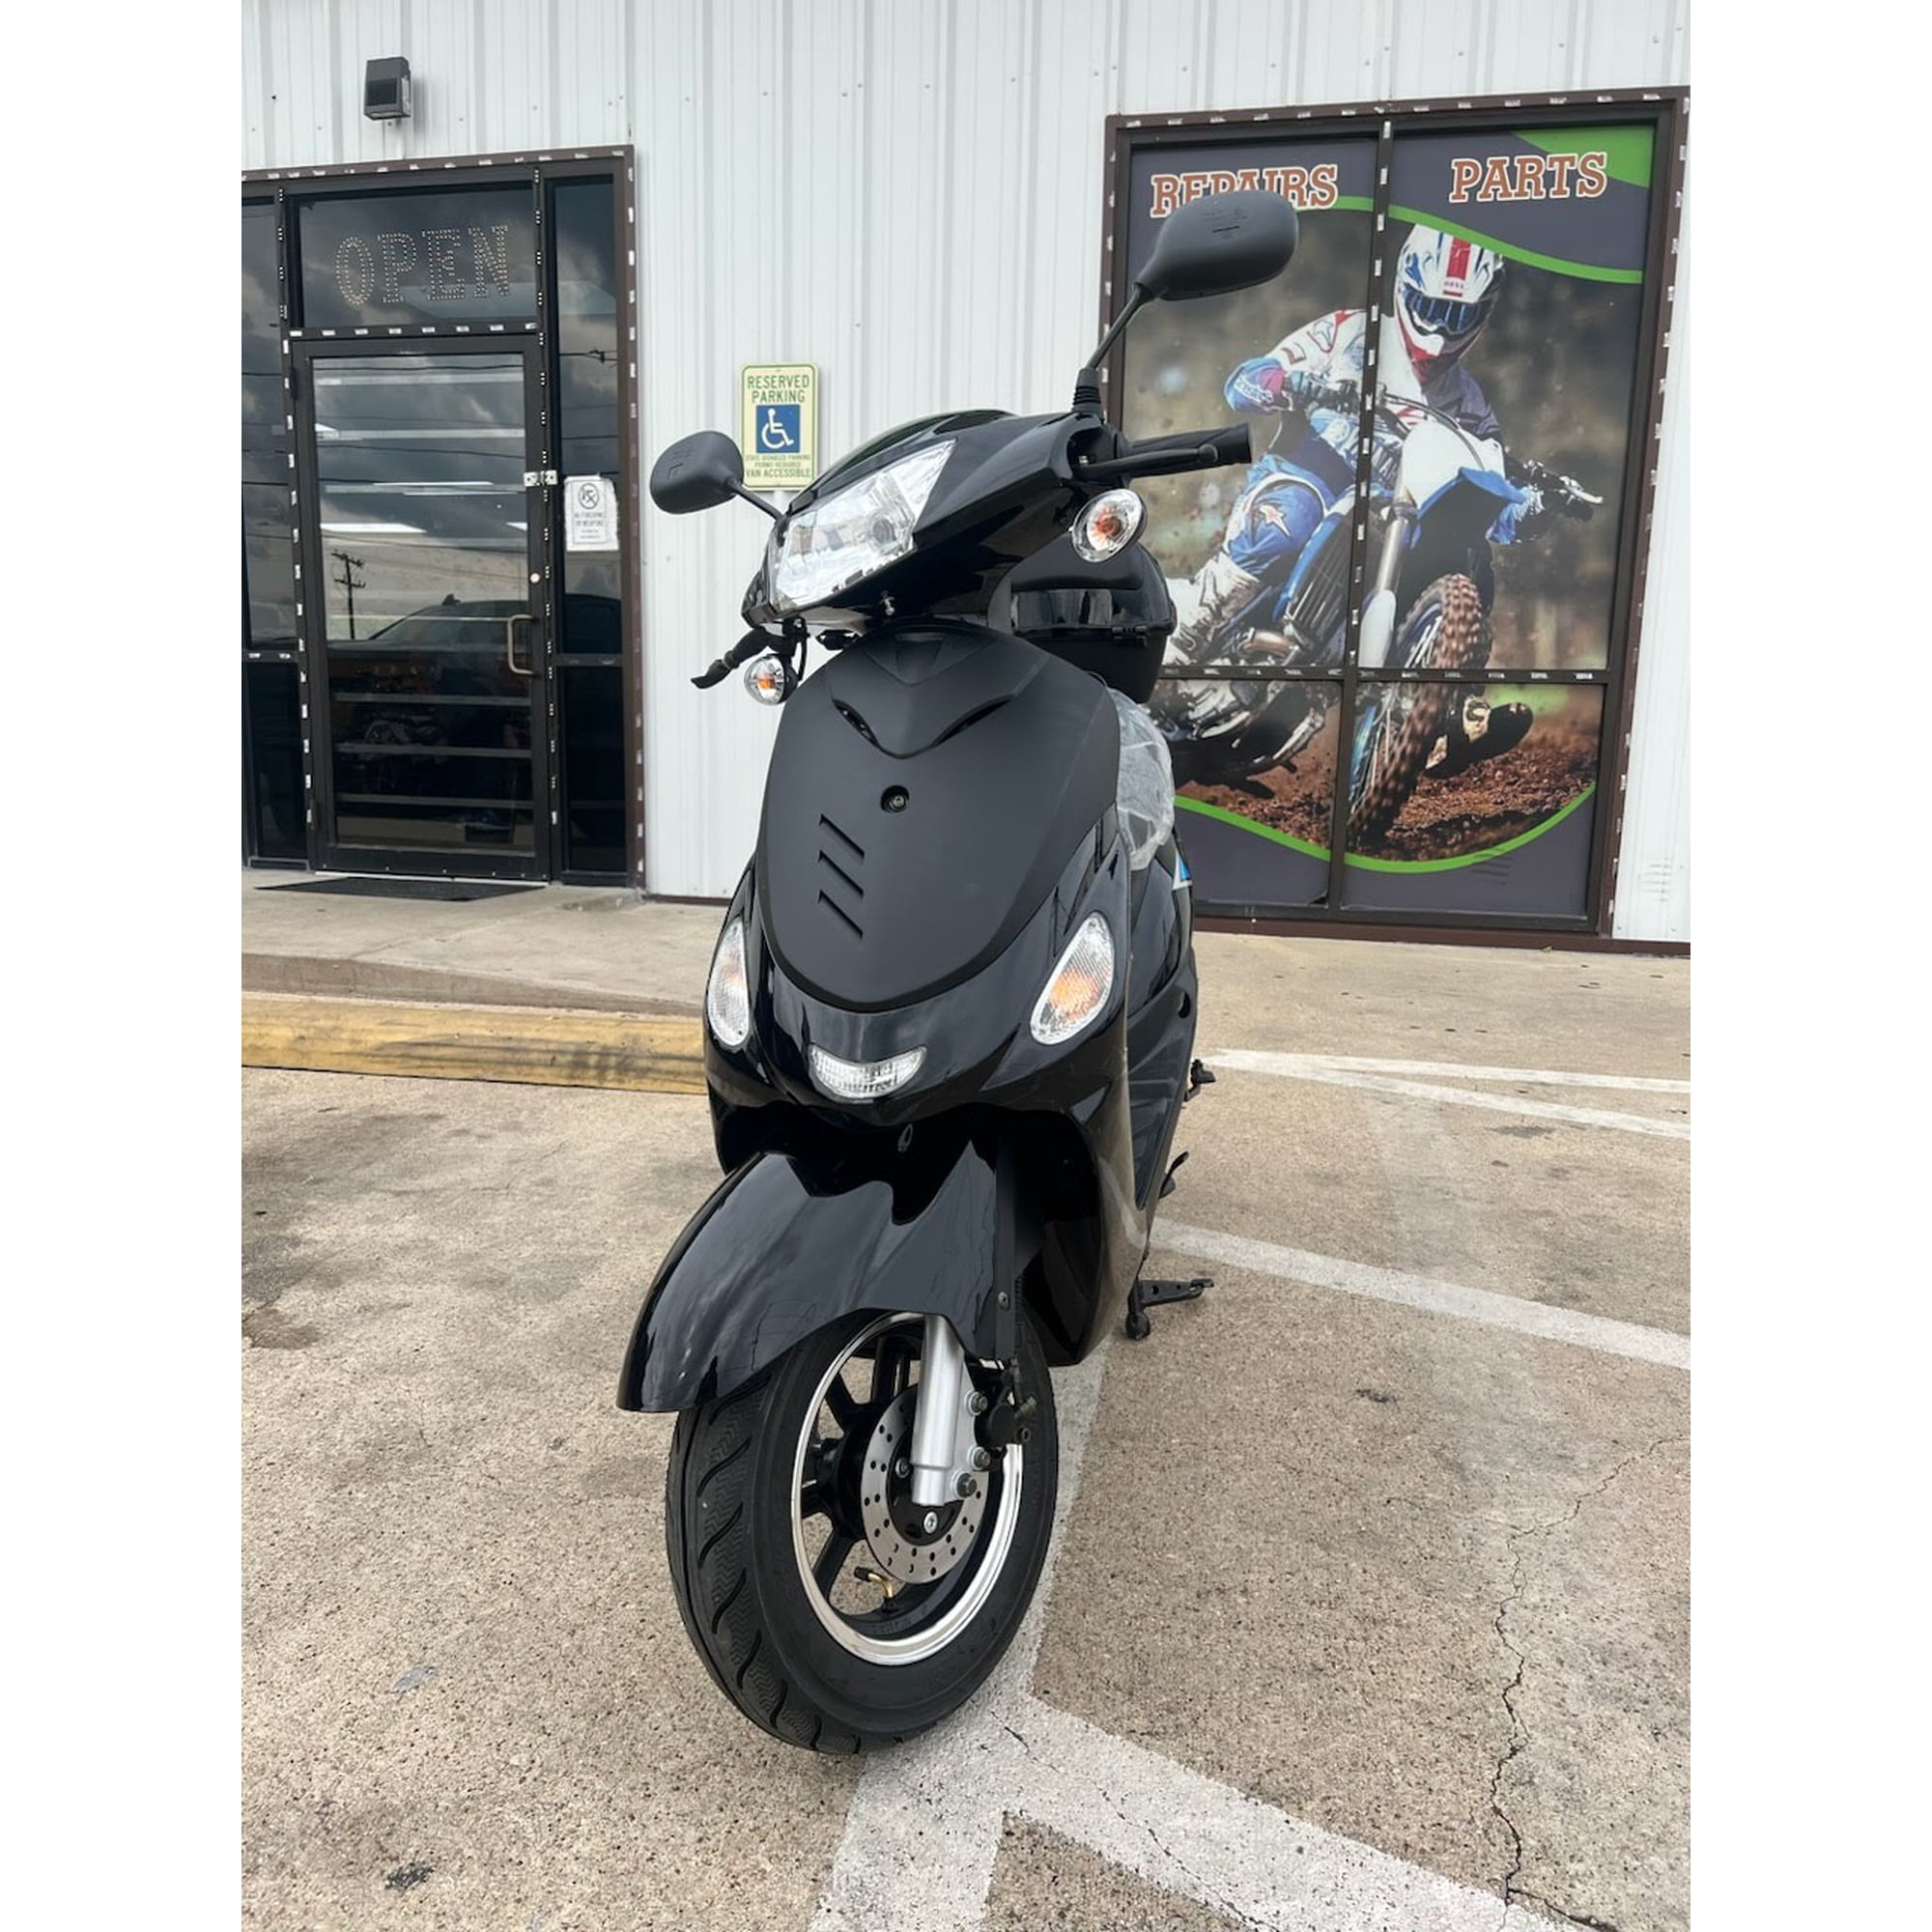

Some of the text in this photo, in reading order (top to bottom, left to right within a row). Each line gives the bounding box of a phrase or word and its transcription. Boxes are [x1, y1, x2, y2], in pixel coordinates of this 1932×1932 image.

[1449, 152, 1607, 203] PARTS
[336, 225, 508, 307] OPEN
[747, 375, 810, 388] RESERVED
[752, 389, 806, 403] PARKING
[746, 469, 811, 477] VAN ACCESSIBLE
